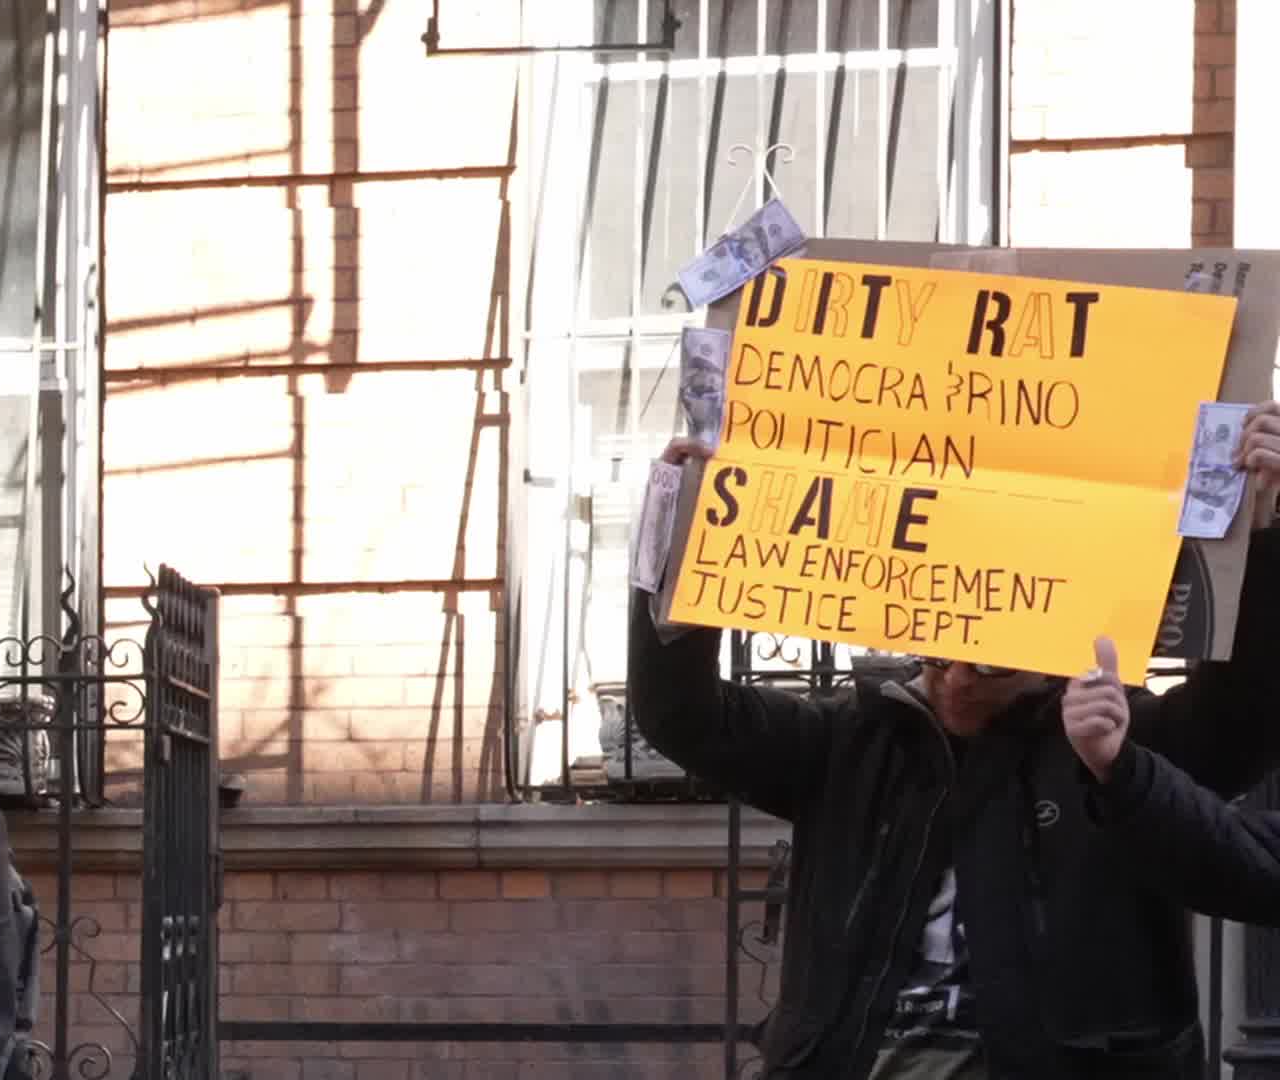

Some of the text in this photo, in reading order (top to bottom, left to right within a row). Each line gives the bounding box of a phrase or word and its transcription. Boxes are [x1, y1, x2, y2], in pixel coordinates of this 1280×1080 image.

[966, 290, 1100, 358] RAT
[688, 569, 985, 646] JUSTICE DEPT.
[695, 529, 1067, 614] LAW ENFORCEMENT
